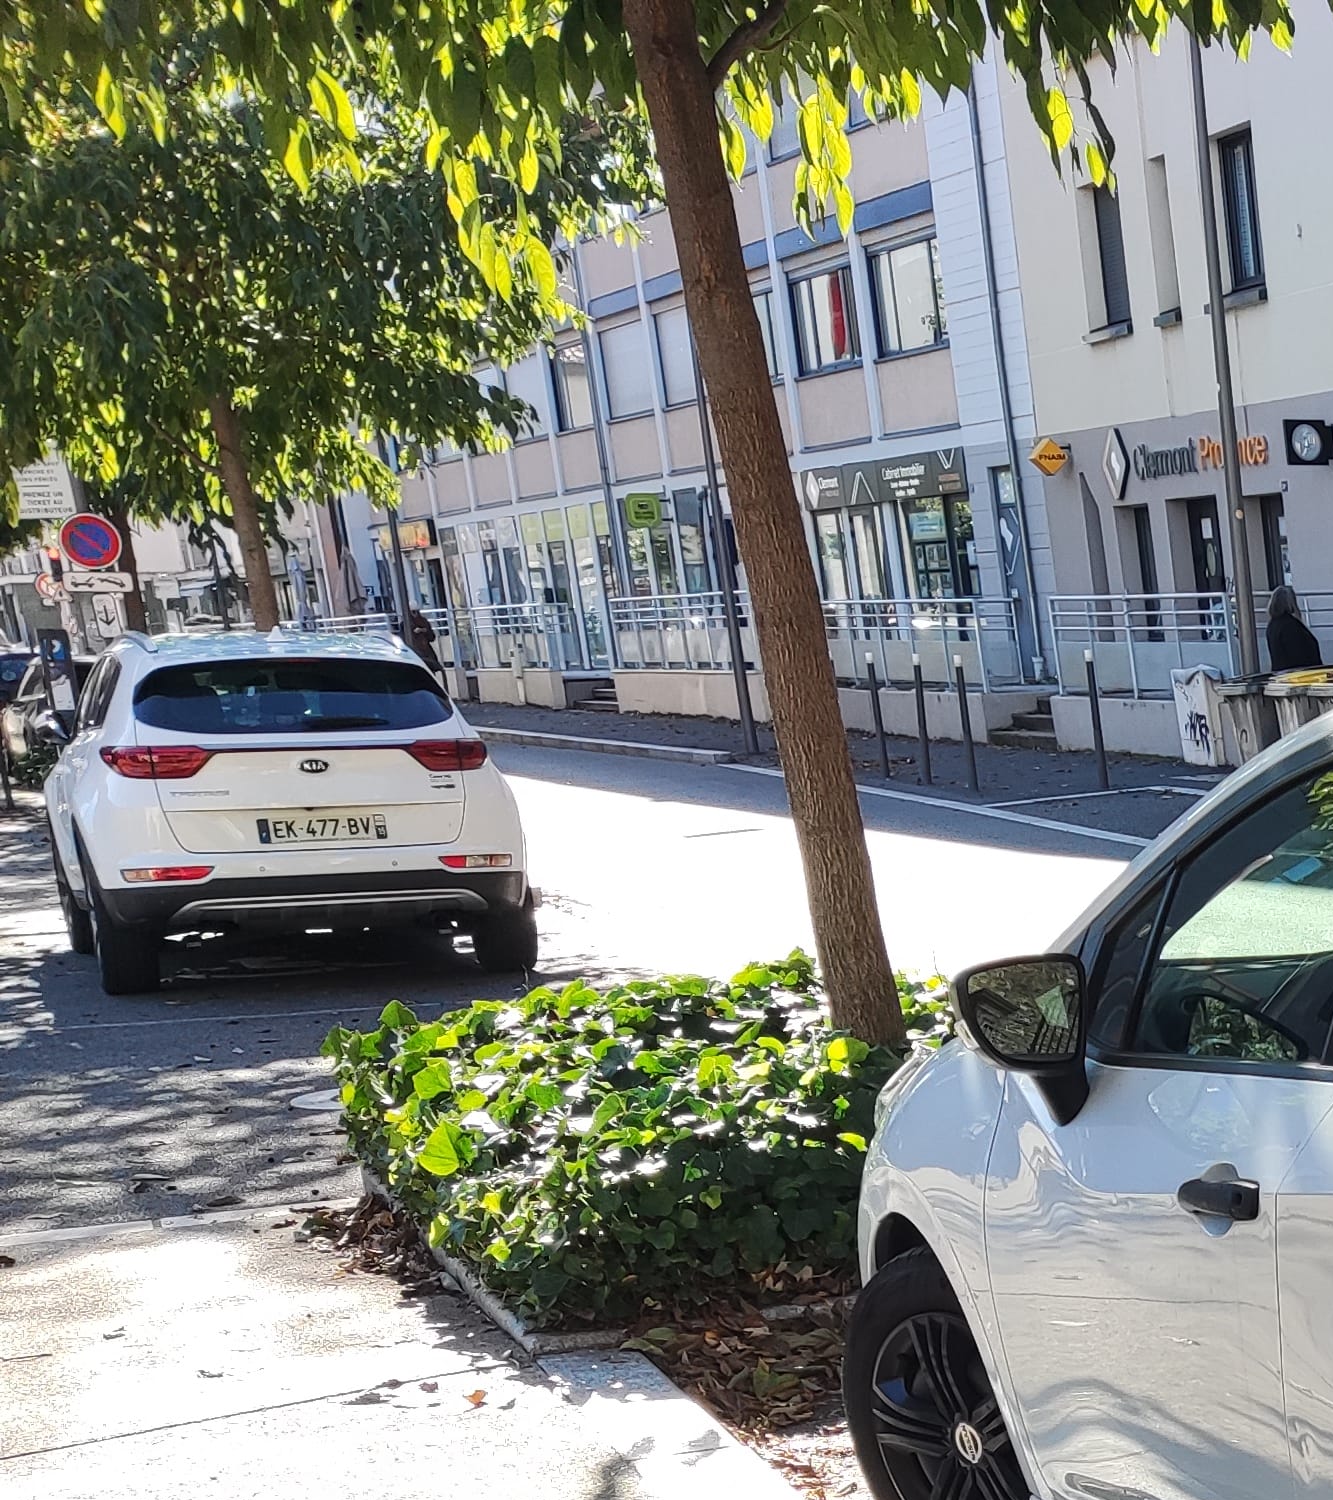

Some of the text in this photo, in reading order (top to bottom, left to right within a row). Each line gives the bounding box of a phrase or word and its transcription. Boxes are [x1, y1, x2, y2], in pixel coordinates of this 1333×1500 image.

[1134, 435, 1269, 480] Clermont Pronce
[303, 761, 327, 771] KIA
[271, 816, 371, 839] EK-477-BV
